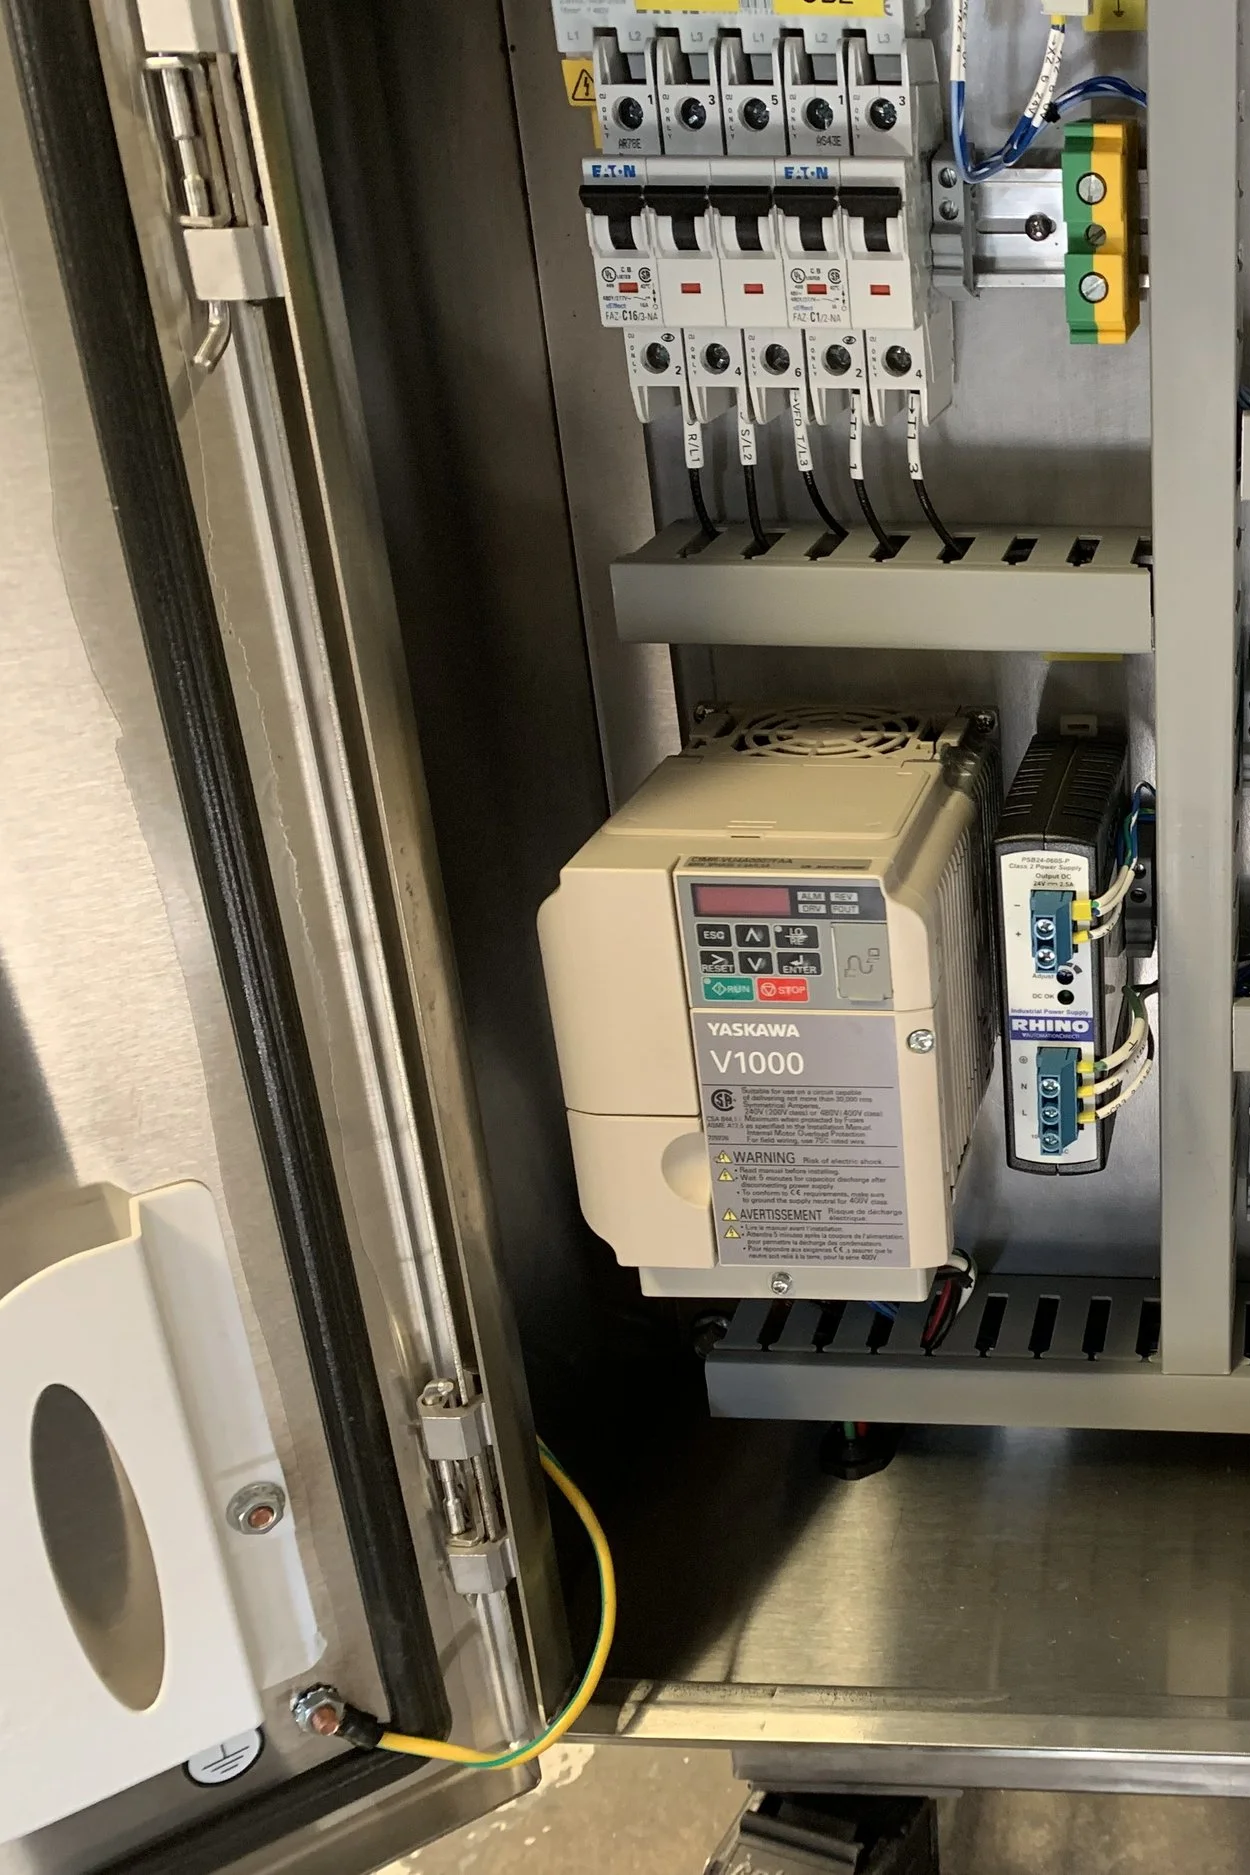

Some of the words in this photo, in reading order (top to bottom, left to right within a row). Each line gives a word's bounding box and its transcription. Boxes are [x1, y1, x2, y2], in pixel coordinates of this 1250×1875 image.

[567, 32, 579, 40] L1
[628, 32, 641, 41] L2
[691, 32, 703, 42] L3
[753, 33, 764, 42] L1
[815, 34, 828, 43] L2
[877, 34, 890, 44] L3
[648, 95, 653, 104] 1
[709, 95, 715, 105] 3
[772, 95, 779, 106] 5
[838, 95, 843, 105] 1
[899, 95, 906, 106] 3
[675, 366, 682, 376] 2
[735, 367, 742, 376] 4
[794, 368, 801, 377] 6
[855, 368, 862, 378] 2
[915, 370, 923, 379] 4
[849, 417, 857, 441] T1
[907, 416, 916, 440] T1
[688, 433, 700, 463] R/L1
[741, 428, 753, 461] S/L2
[908, 463, 919, 474] 3
[801, 892, 823, 900] ALM
[834, 892, 853, 900] REV
[703, 931, 725, 940] ESC
[701, 964, 734, 973] RESET
[783, 965, 817, 975] ENTER
[727, 984, 750, 993] RUN
[778, 985, 806, 995] STOP
[707, 1023, 800, 1037] YASKAWA
[1012, 1019, 1089, 1032] RHINO
[709, 1050, 804, 1075] V1000
[733, 1151, 796, 1164] WARNING
[837, 1176, 869, 1184] discharge
[740, 1208, 823, 1221] AVERTISSEMENT
[828, 1208, 855, 1216] Risque
